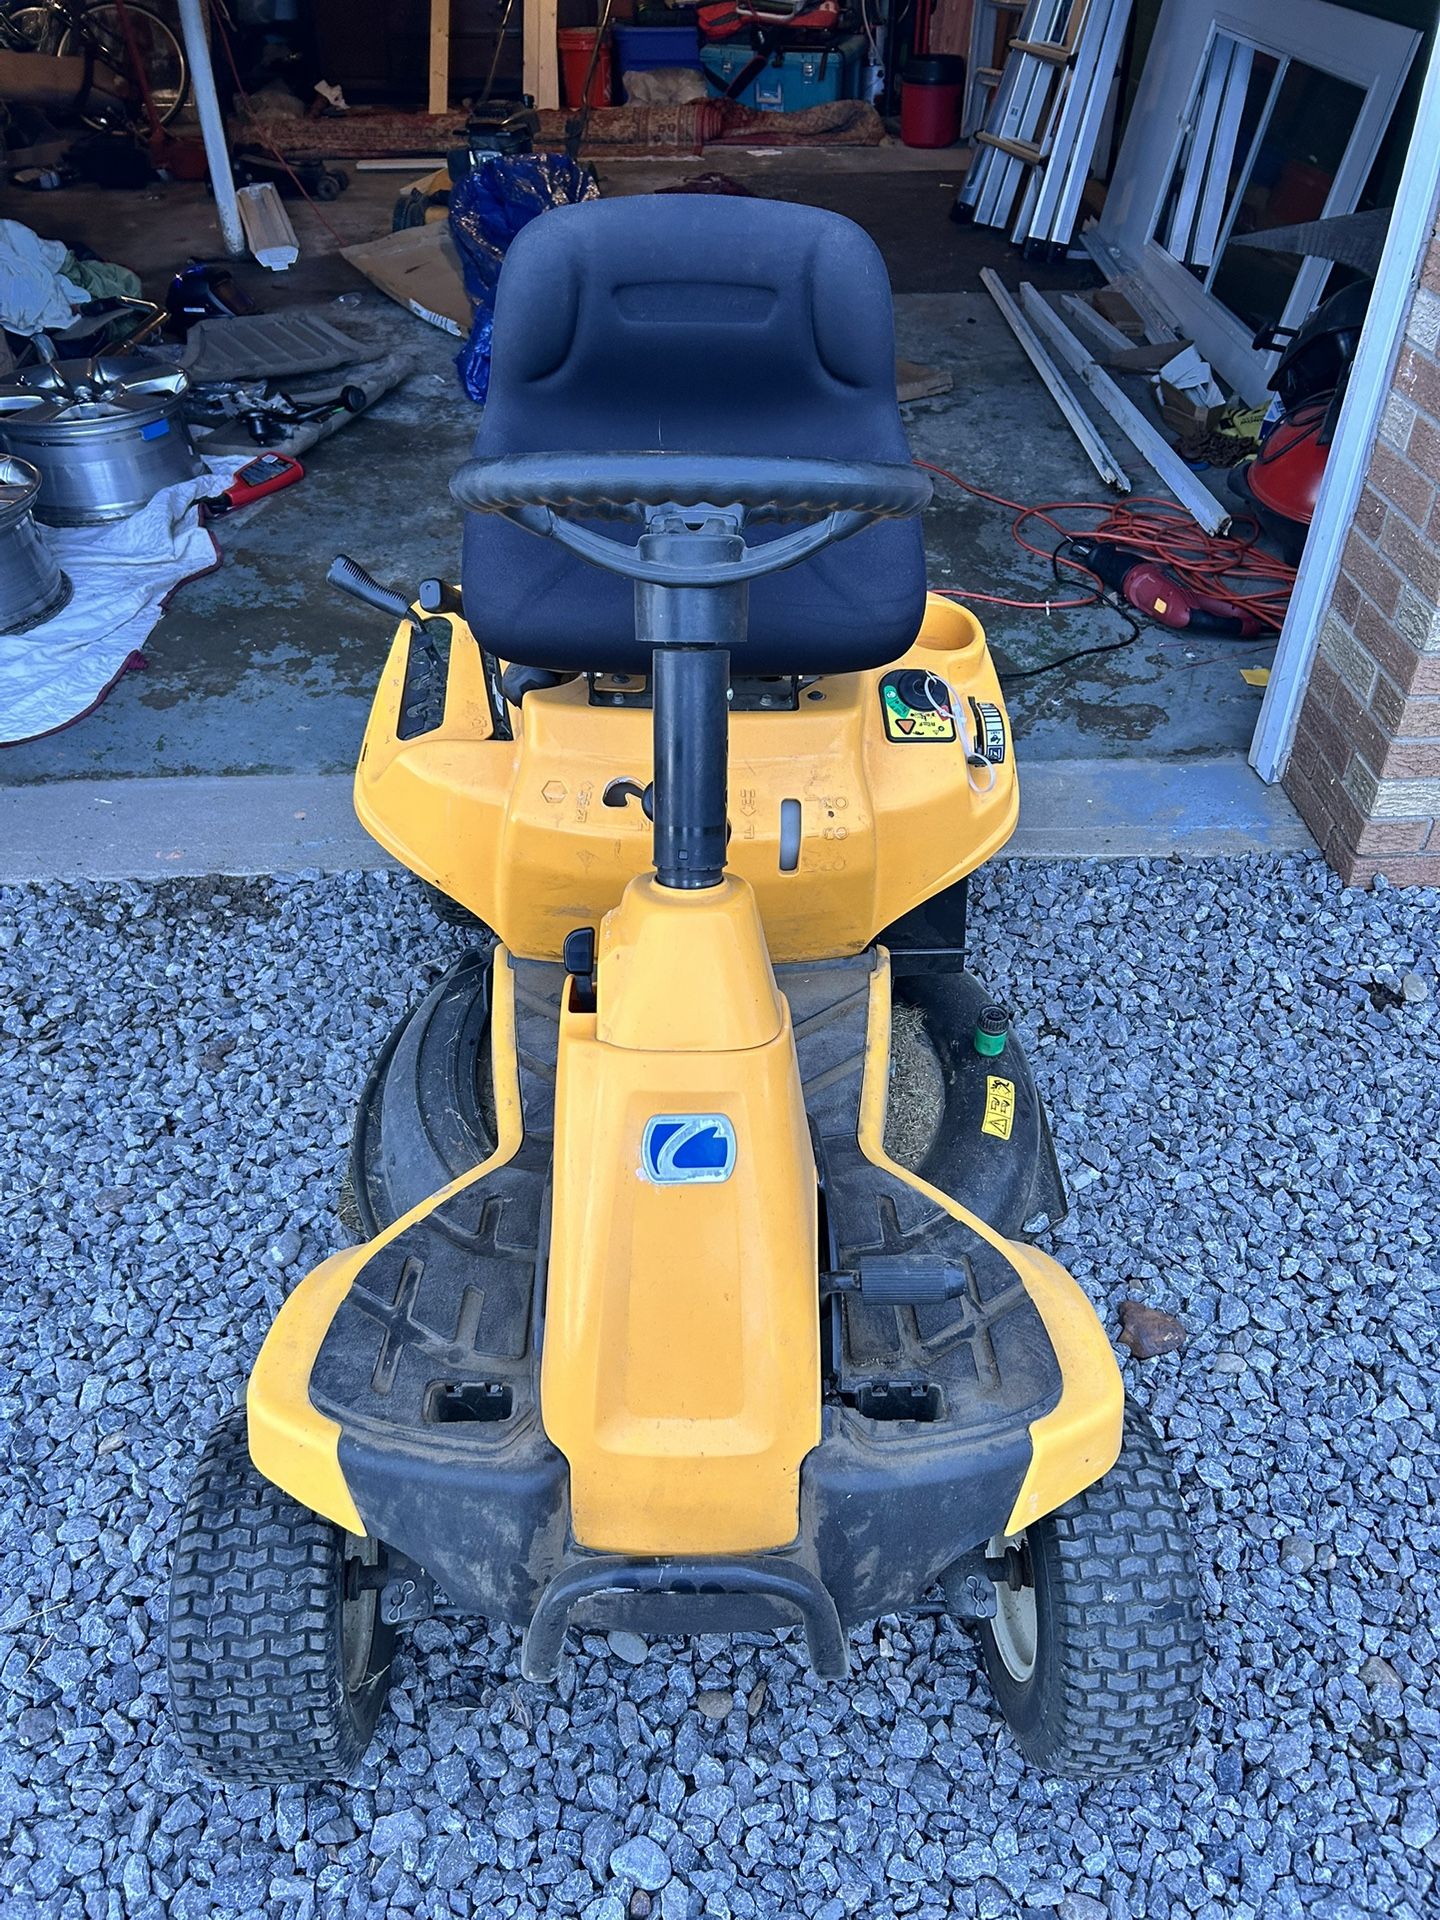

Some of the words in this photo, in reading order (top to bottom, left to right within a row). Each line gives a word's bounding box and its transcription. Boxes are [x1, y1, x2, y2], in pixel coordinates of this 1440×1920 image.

[576, 809, 588, 823] R
[638, 819, 652, 832] N
[743, 825, 755, 840] F
